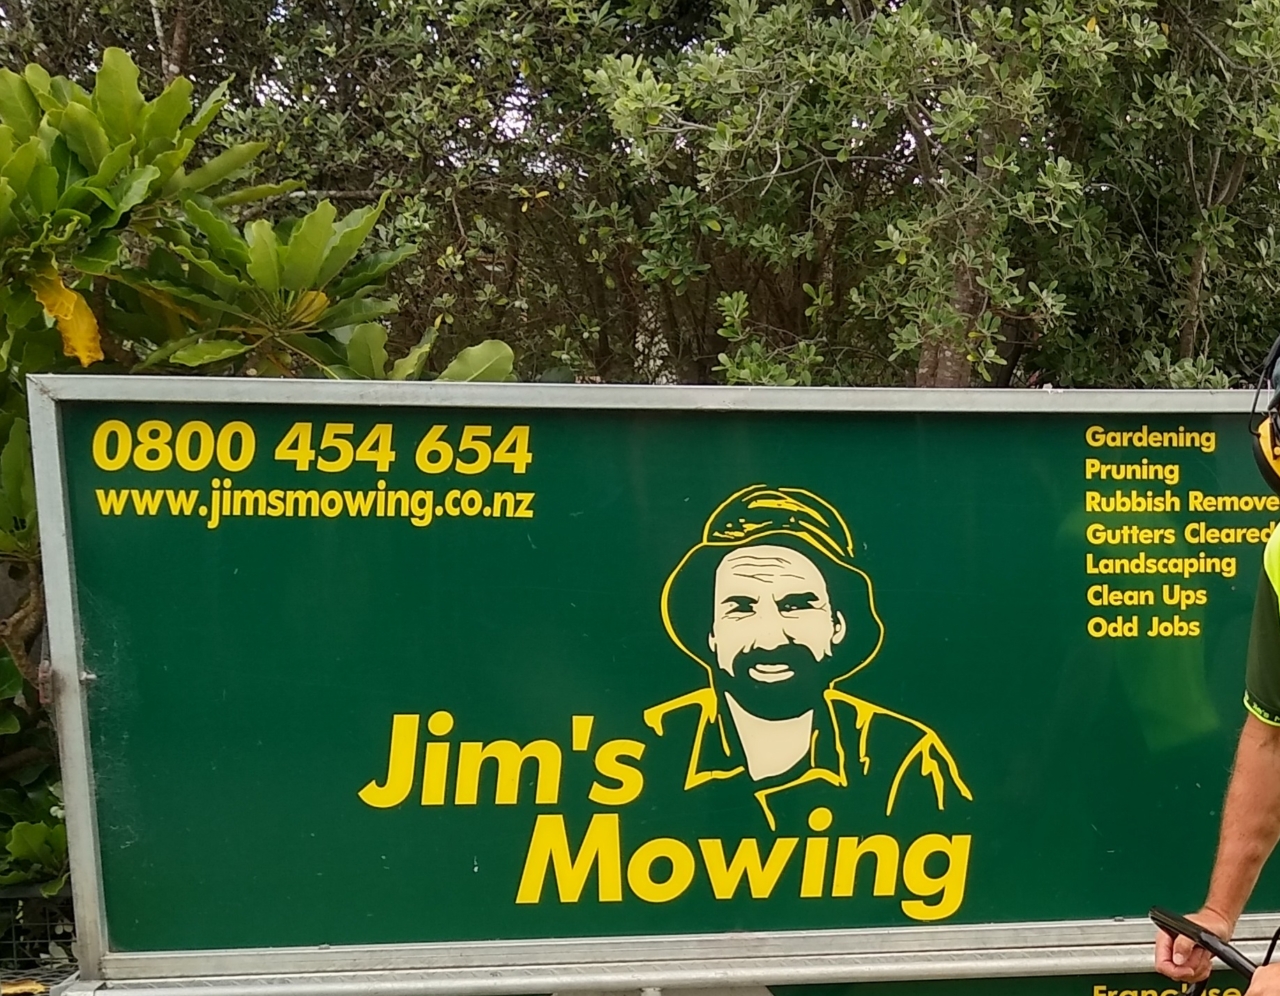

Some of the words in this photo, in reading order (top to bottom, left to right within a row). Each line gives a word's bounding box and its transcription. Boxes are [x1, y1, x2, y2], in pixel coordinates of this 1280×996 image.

[92, 420, 256, 472] 0800
[275, 423, 396, 473] 454
[415, 425, 533, 475] 654
[1085, 426, 1216, 452] Gardening
[1085, 459, 1180, 485] Pruning
[95, 478, 535, 529] www.jimsmowing.co.nz
[1085, 490, 1181, 512] Rubbish
[1086, 523, 1176, 544] Gutters
[1184, 522, 1276, 544] Cleared
[1086, 552, 1237, 578] Landscaping
[1086, 584, 1155, 606] Clean
[1162, 585, 1208, 610] Ups
[1087, 616, 1139, 637] Odd
[1147, 615, 1201, 637] Jobs
[358, 711, 646, 809] Jim's
[515, 807, 972, 921] Mowing
